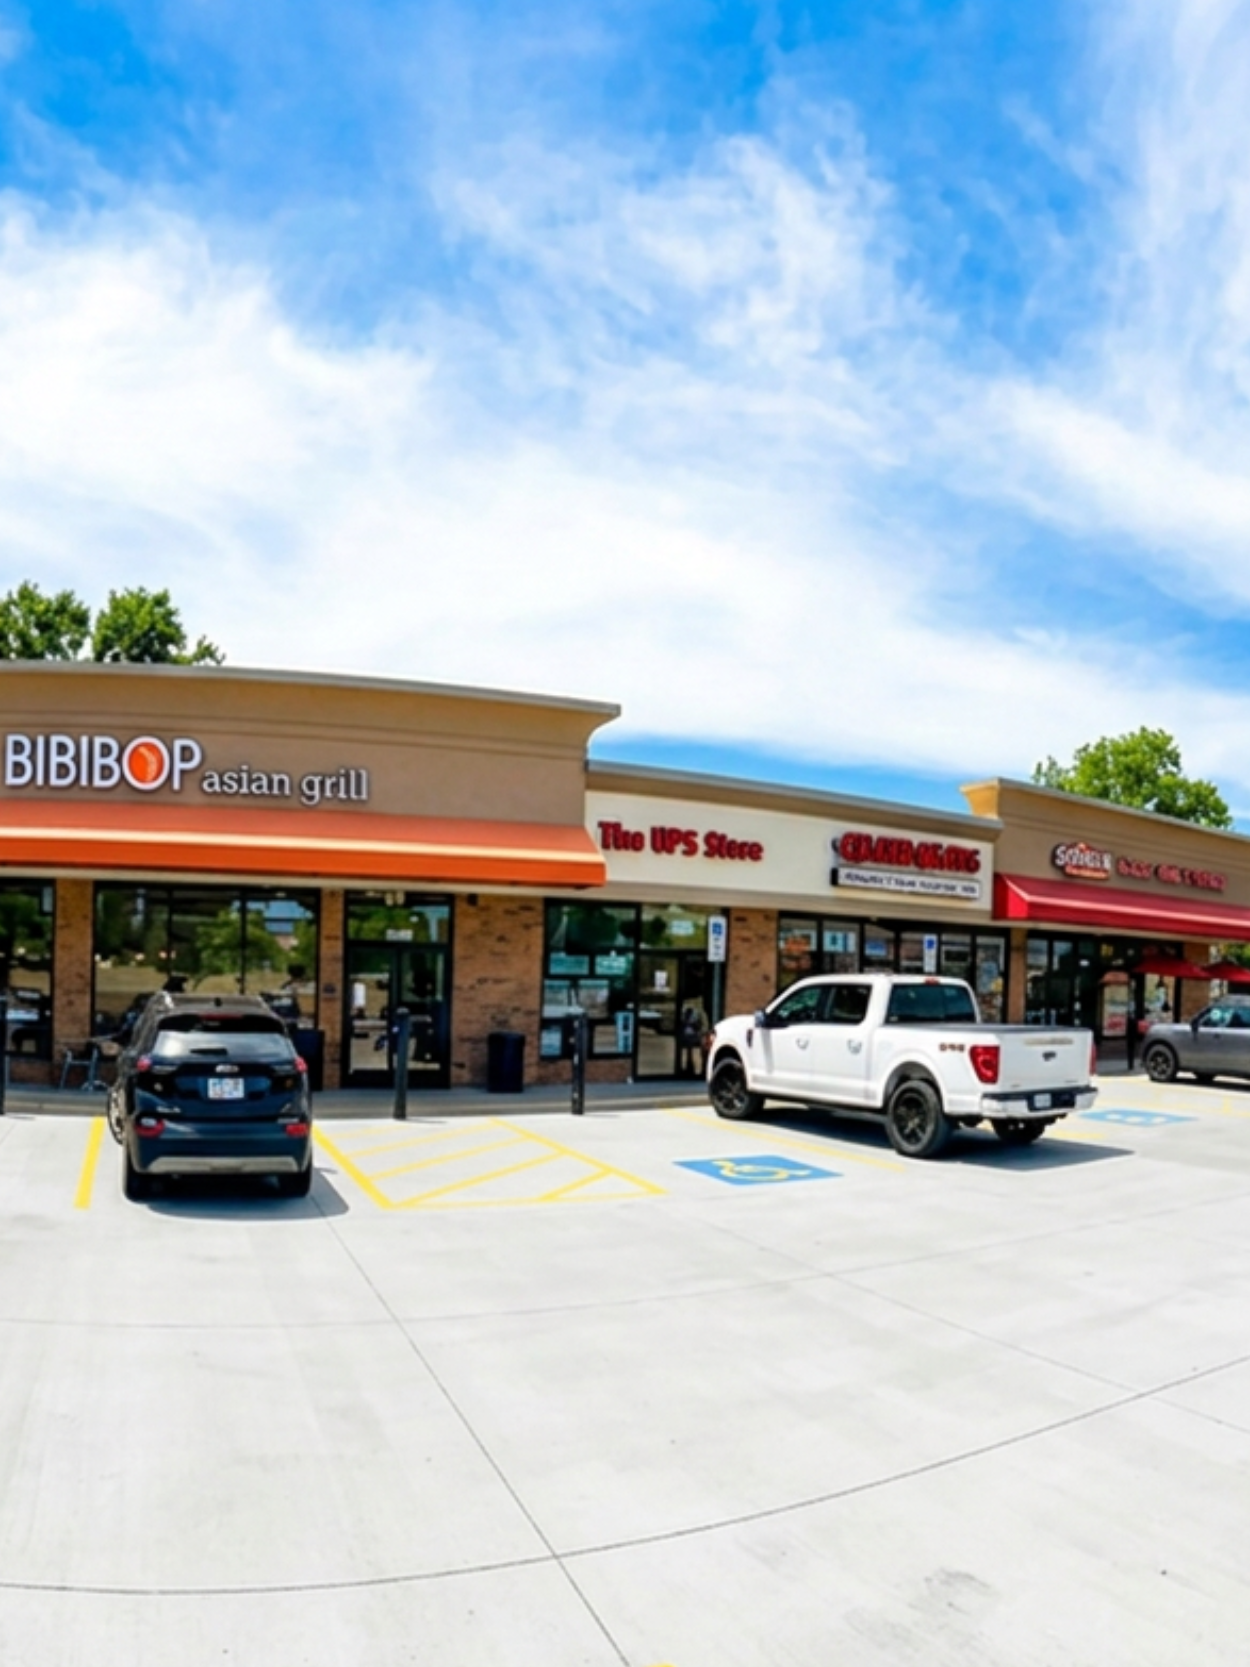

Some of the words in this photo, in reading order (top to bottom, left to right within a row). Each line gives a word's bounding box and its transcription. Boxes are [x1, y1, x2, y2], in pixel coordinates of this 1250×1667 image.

[5, 734, 201, 790] BIBIBOP
[202, 766, 291, 795] asian
[301, 769, 368, 804] grill
[597, 820, 645, 851] The
[650, 826, 698, 857] UPS
[703, 830, 764, 862] Store
